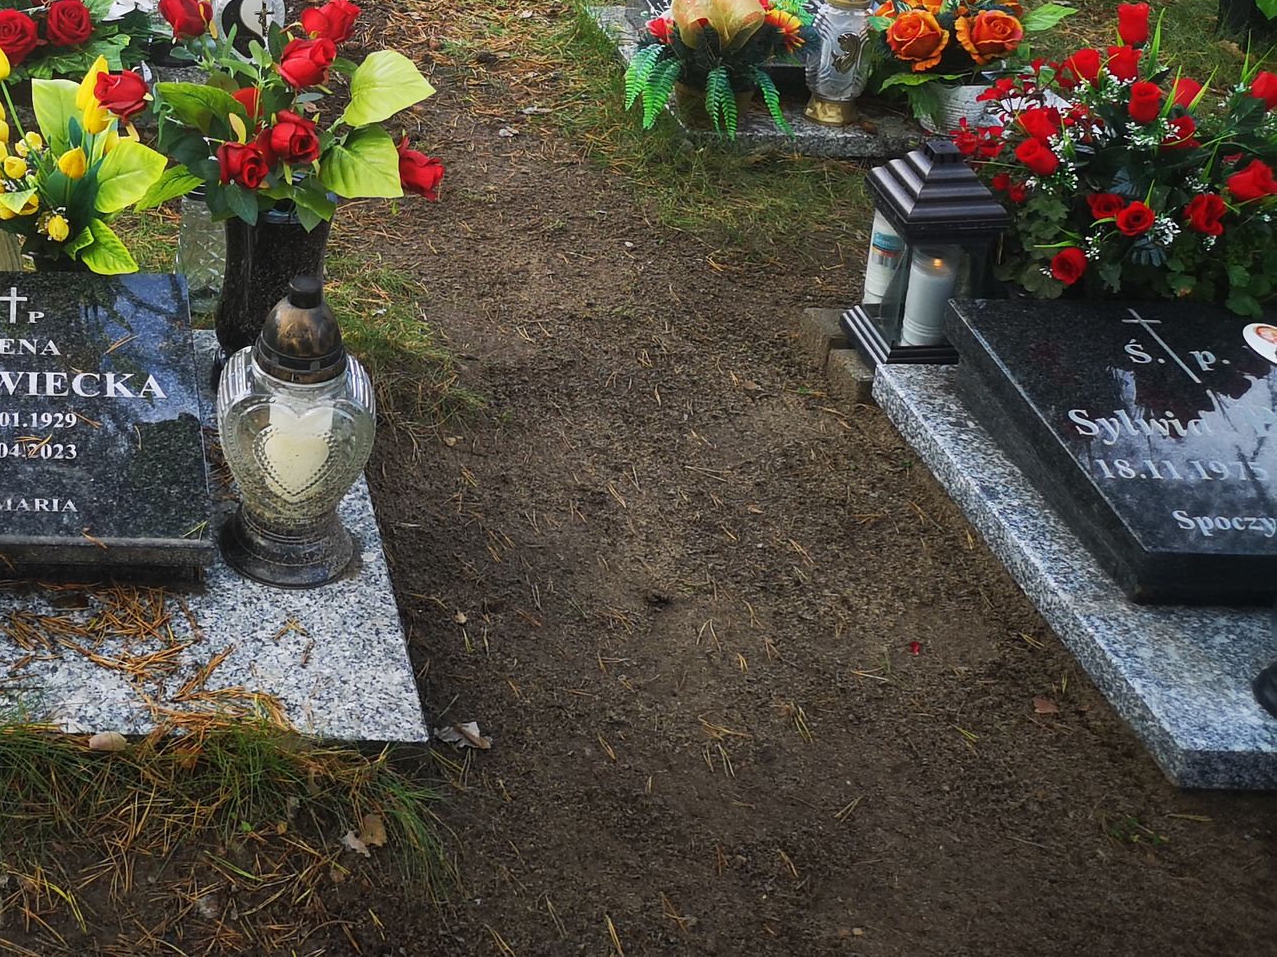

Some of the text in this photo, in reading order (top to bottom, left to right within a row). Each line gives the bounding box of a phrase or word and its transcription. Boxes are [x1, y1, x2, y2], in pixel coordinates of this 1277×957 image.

[27, 310, 46, 324] P
[1123, 338, 1166, 364] Ś.
[1067, 409, 1214, 445] Sylwia
